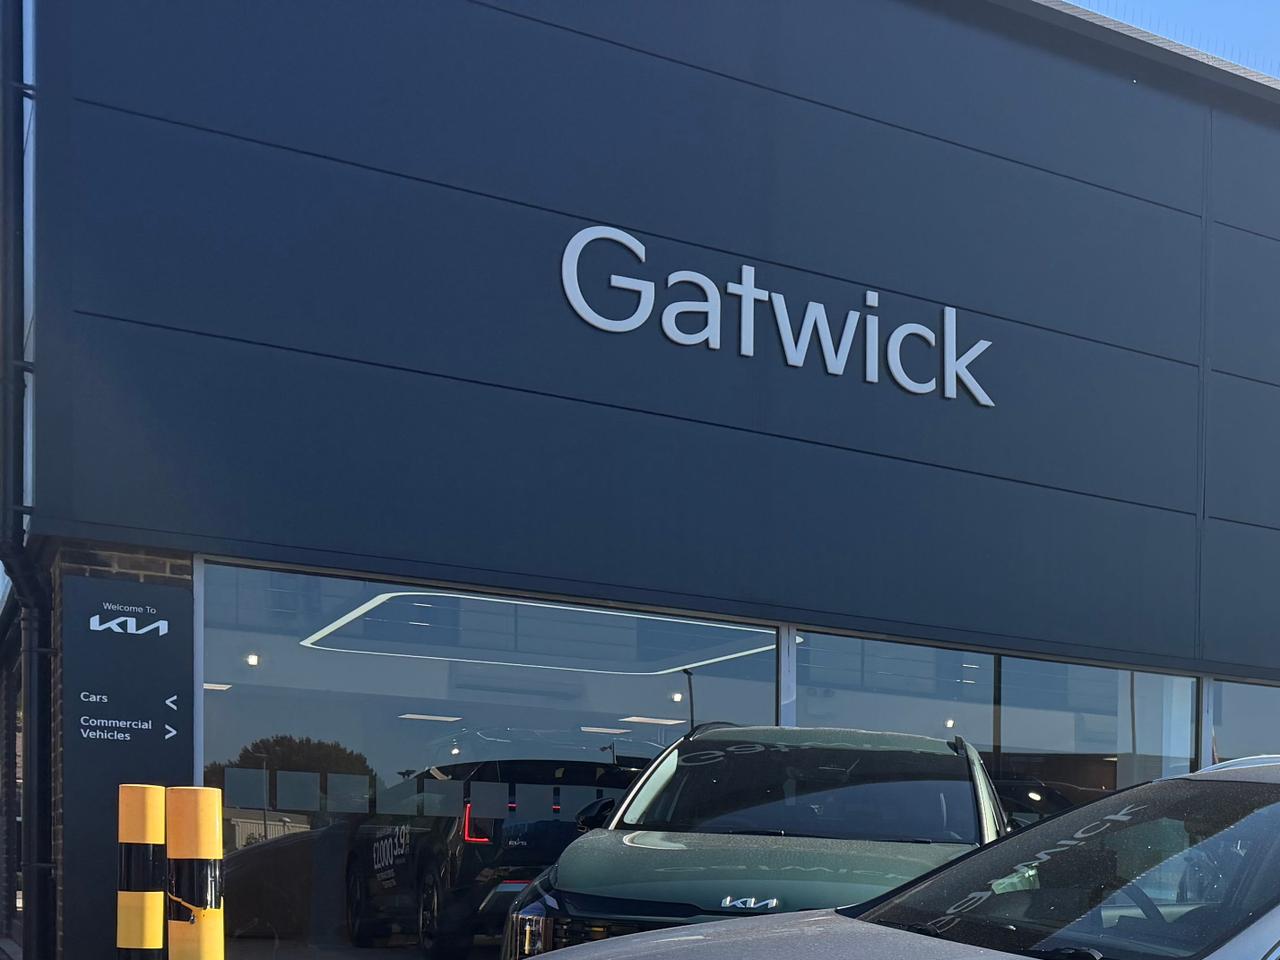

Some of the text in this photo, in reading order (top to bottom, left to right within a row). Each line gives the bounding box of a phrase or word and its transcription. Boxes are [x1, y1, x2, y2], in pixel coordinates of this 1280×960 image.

[562, 226, 995, 408] Gatwick
[103, 602, 157, 614] Welcome To
[89, 614, 169, 637] KIA
[80, 691, 109, 703] Cars
[80, 715, 152, 730] Commercial
[80, 728, 131, 741] Vehicles
